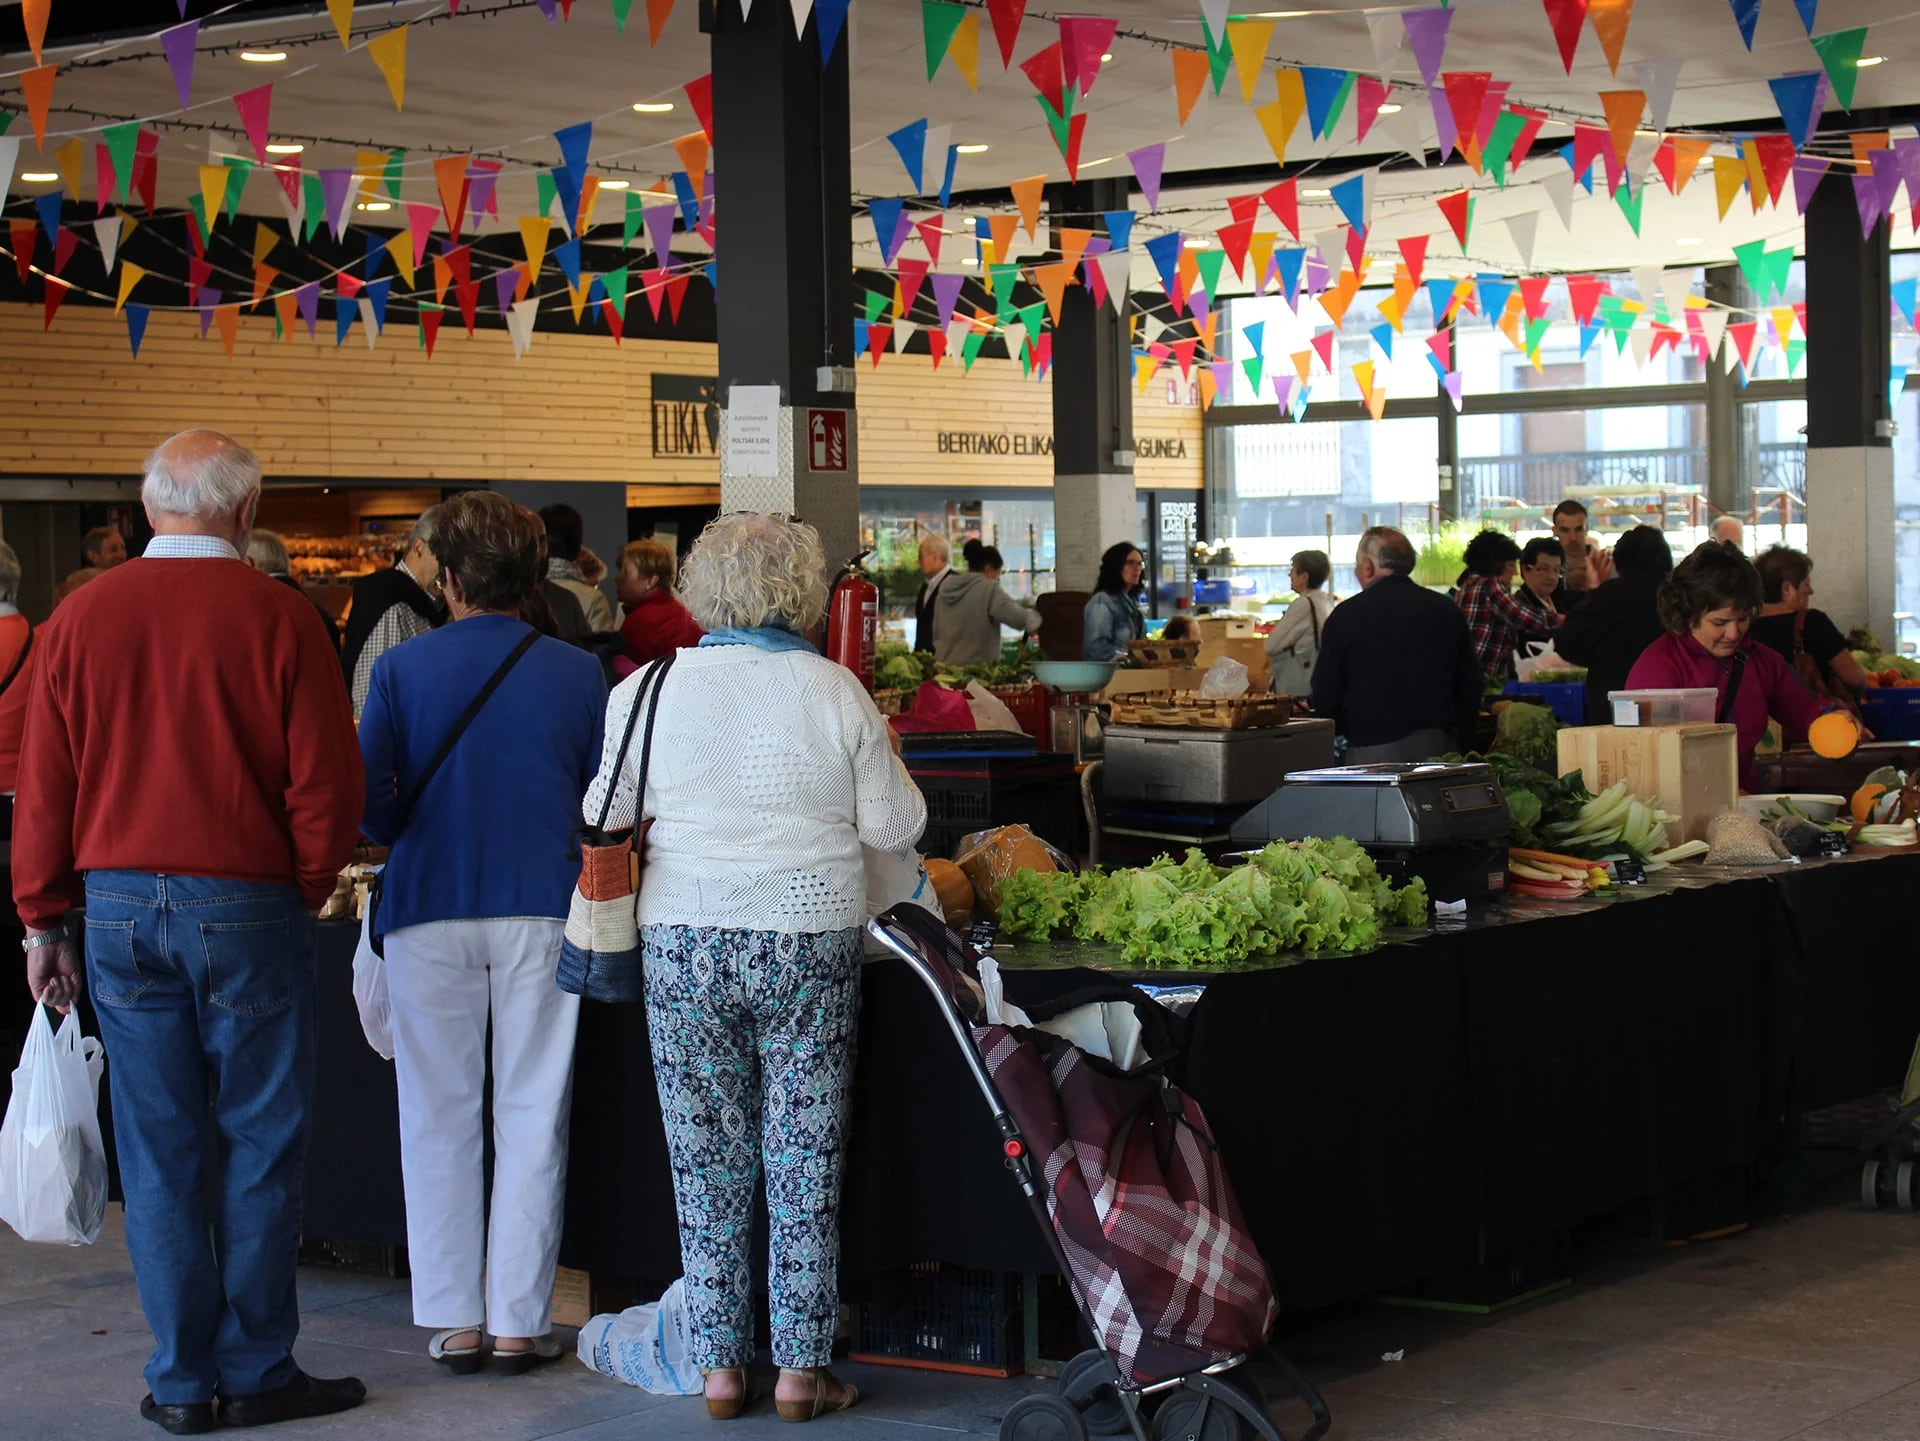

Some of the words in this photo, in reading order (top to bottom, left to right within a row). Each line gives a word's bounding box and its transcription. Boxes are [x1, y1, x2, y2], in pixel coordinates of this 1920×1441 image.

[653, 401, 701, 454] ELIKA
[938, 432, 1010, 455] BERTAKO
[1013, 434, 1056, 456] ELIKA
[1161, 501, 1197, 517] BASQUE
